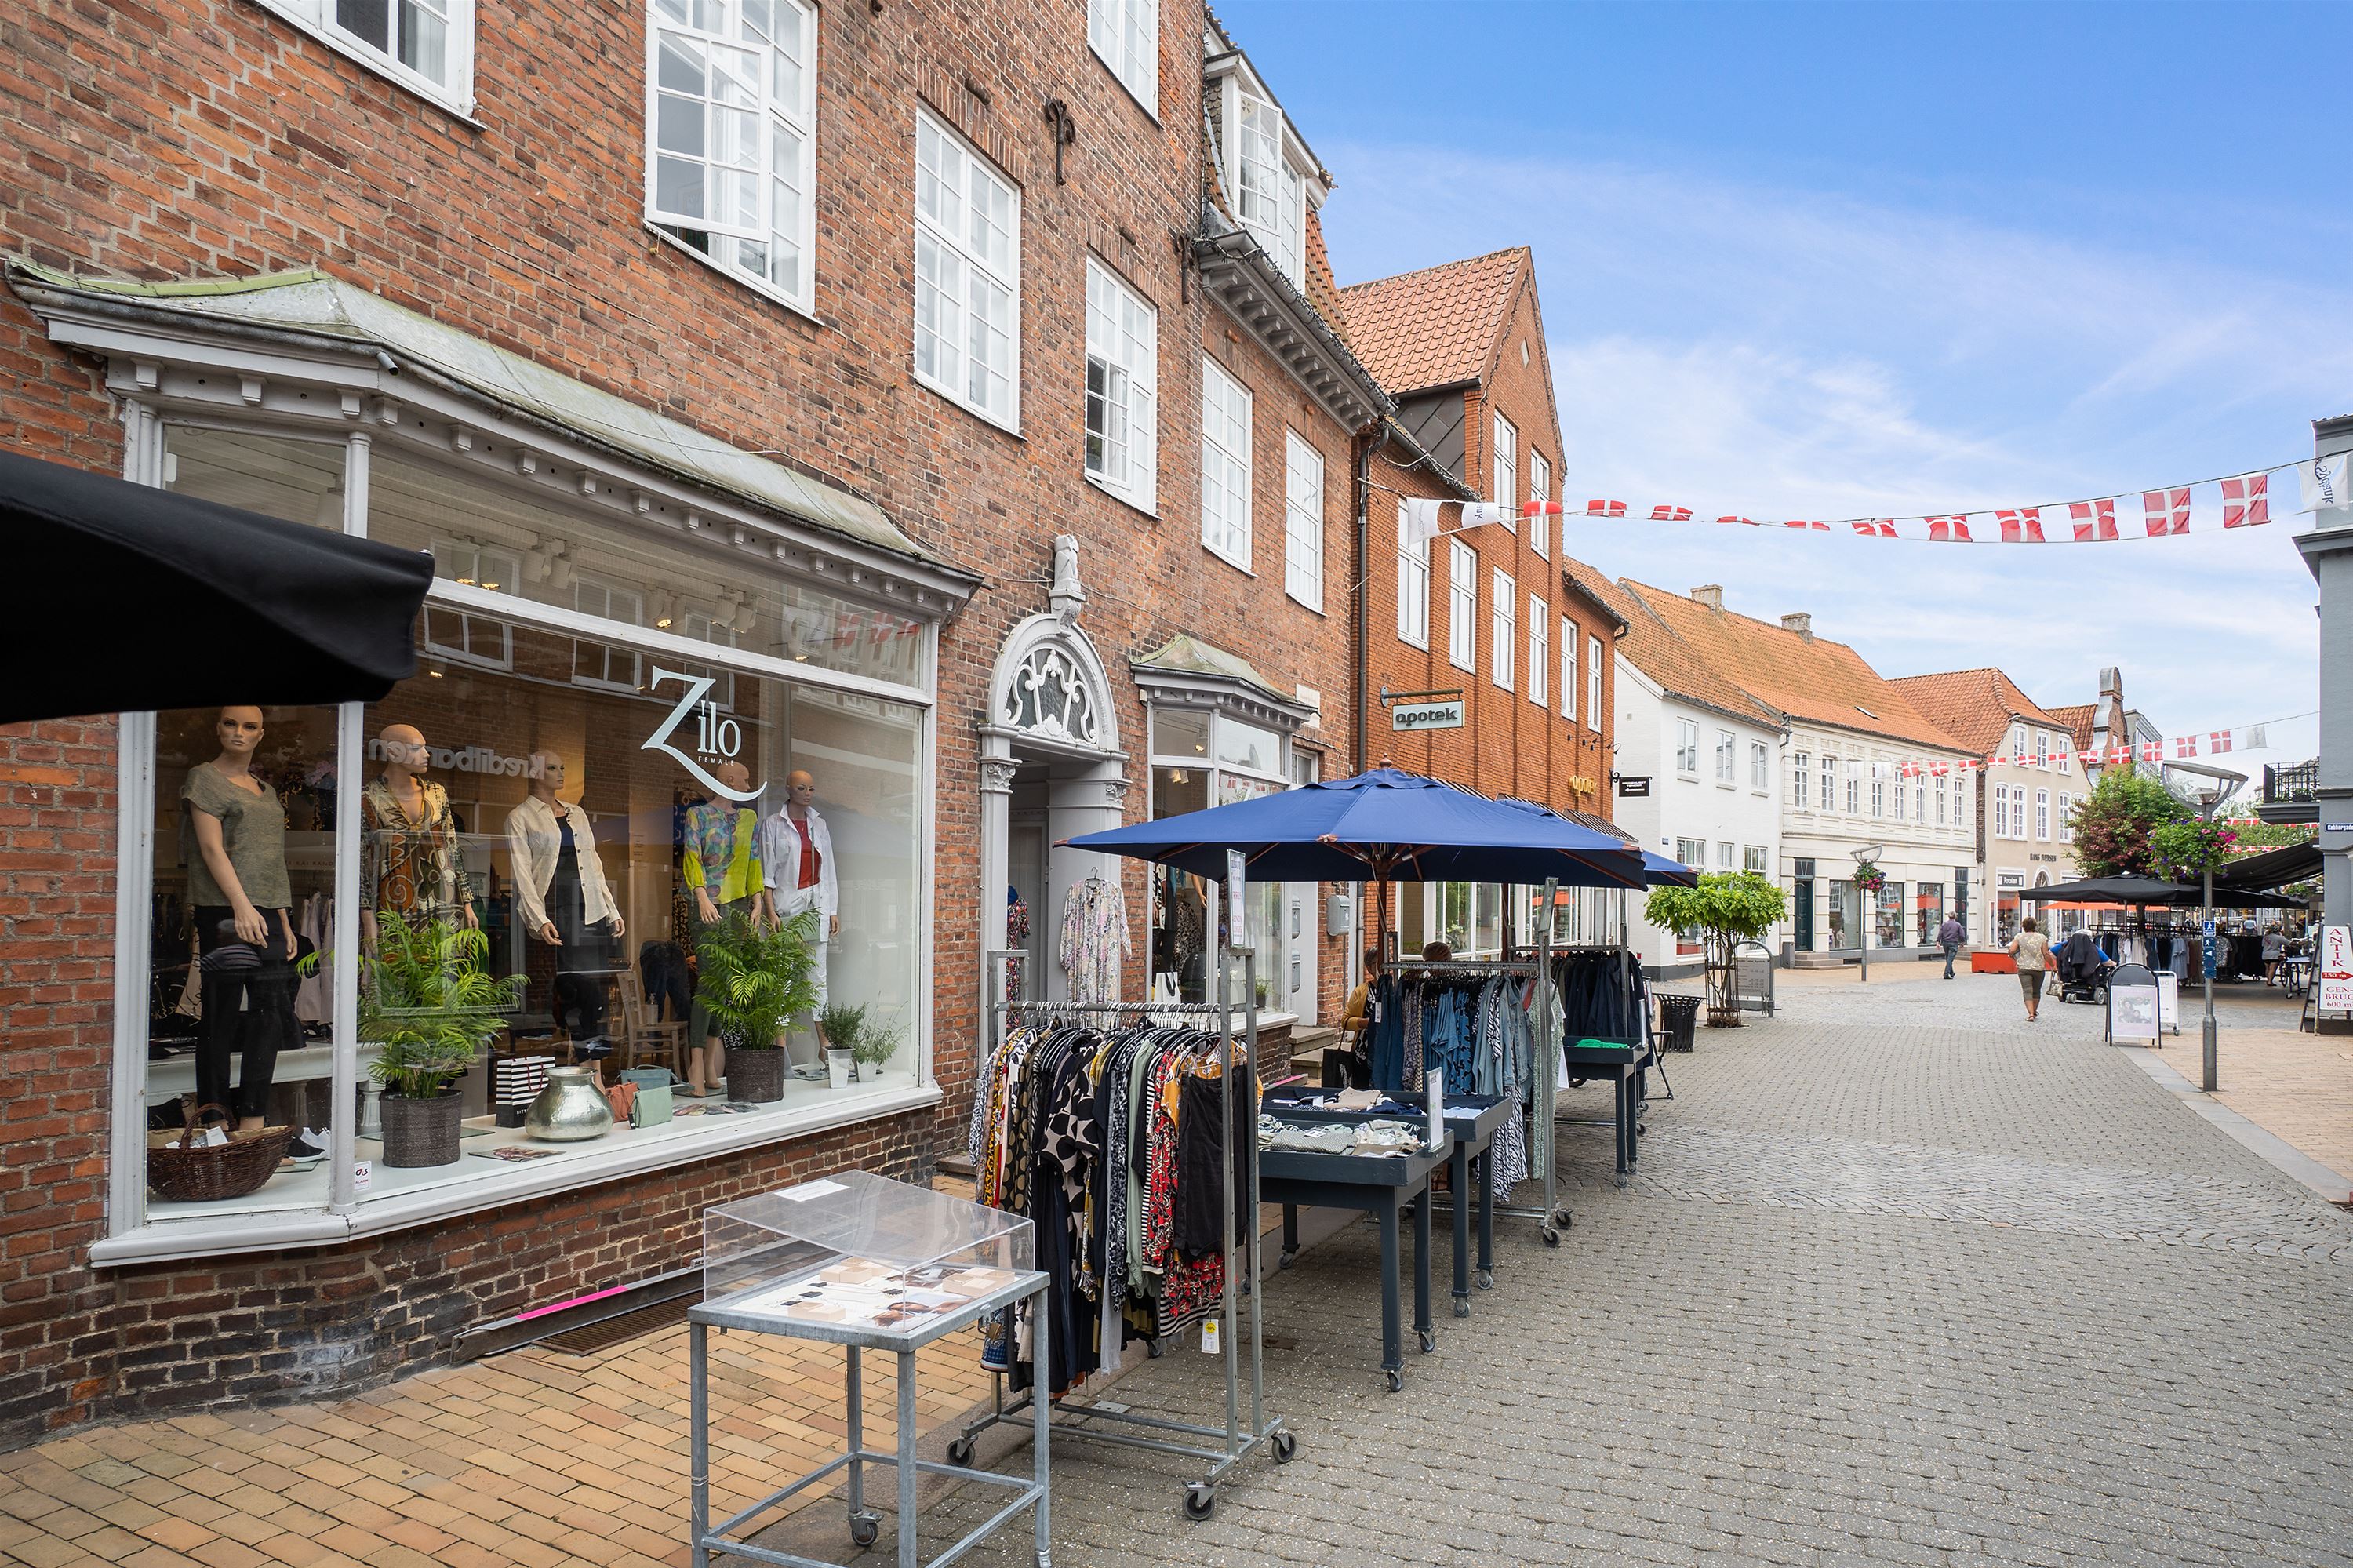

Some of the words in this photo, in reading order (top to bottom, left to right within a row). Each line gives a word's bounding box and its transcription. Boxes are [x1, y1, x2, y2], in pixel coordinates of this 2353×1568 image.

[1395, 708, 1457, 726] apotek
[641, 665, 768, 802] Zilo
[698, 755, 735, 766] FEMALE
[2329, 928, 2345, 967] ANTIK
